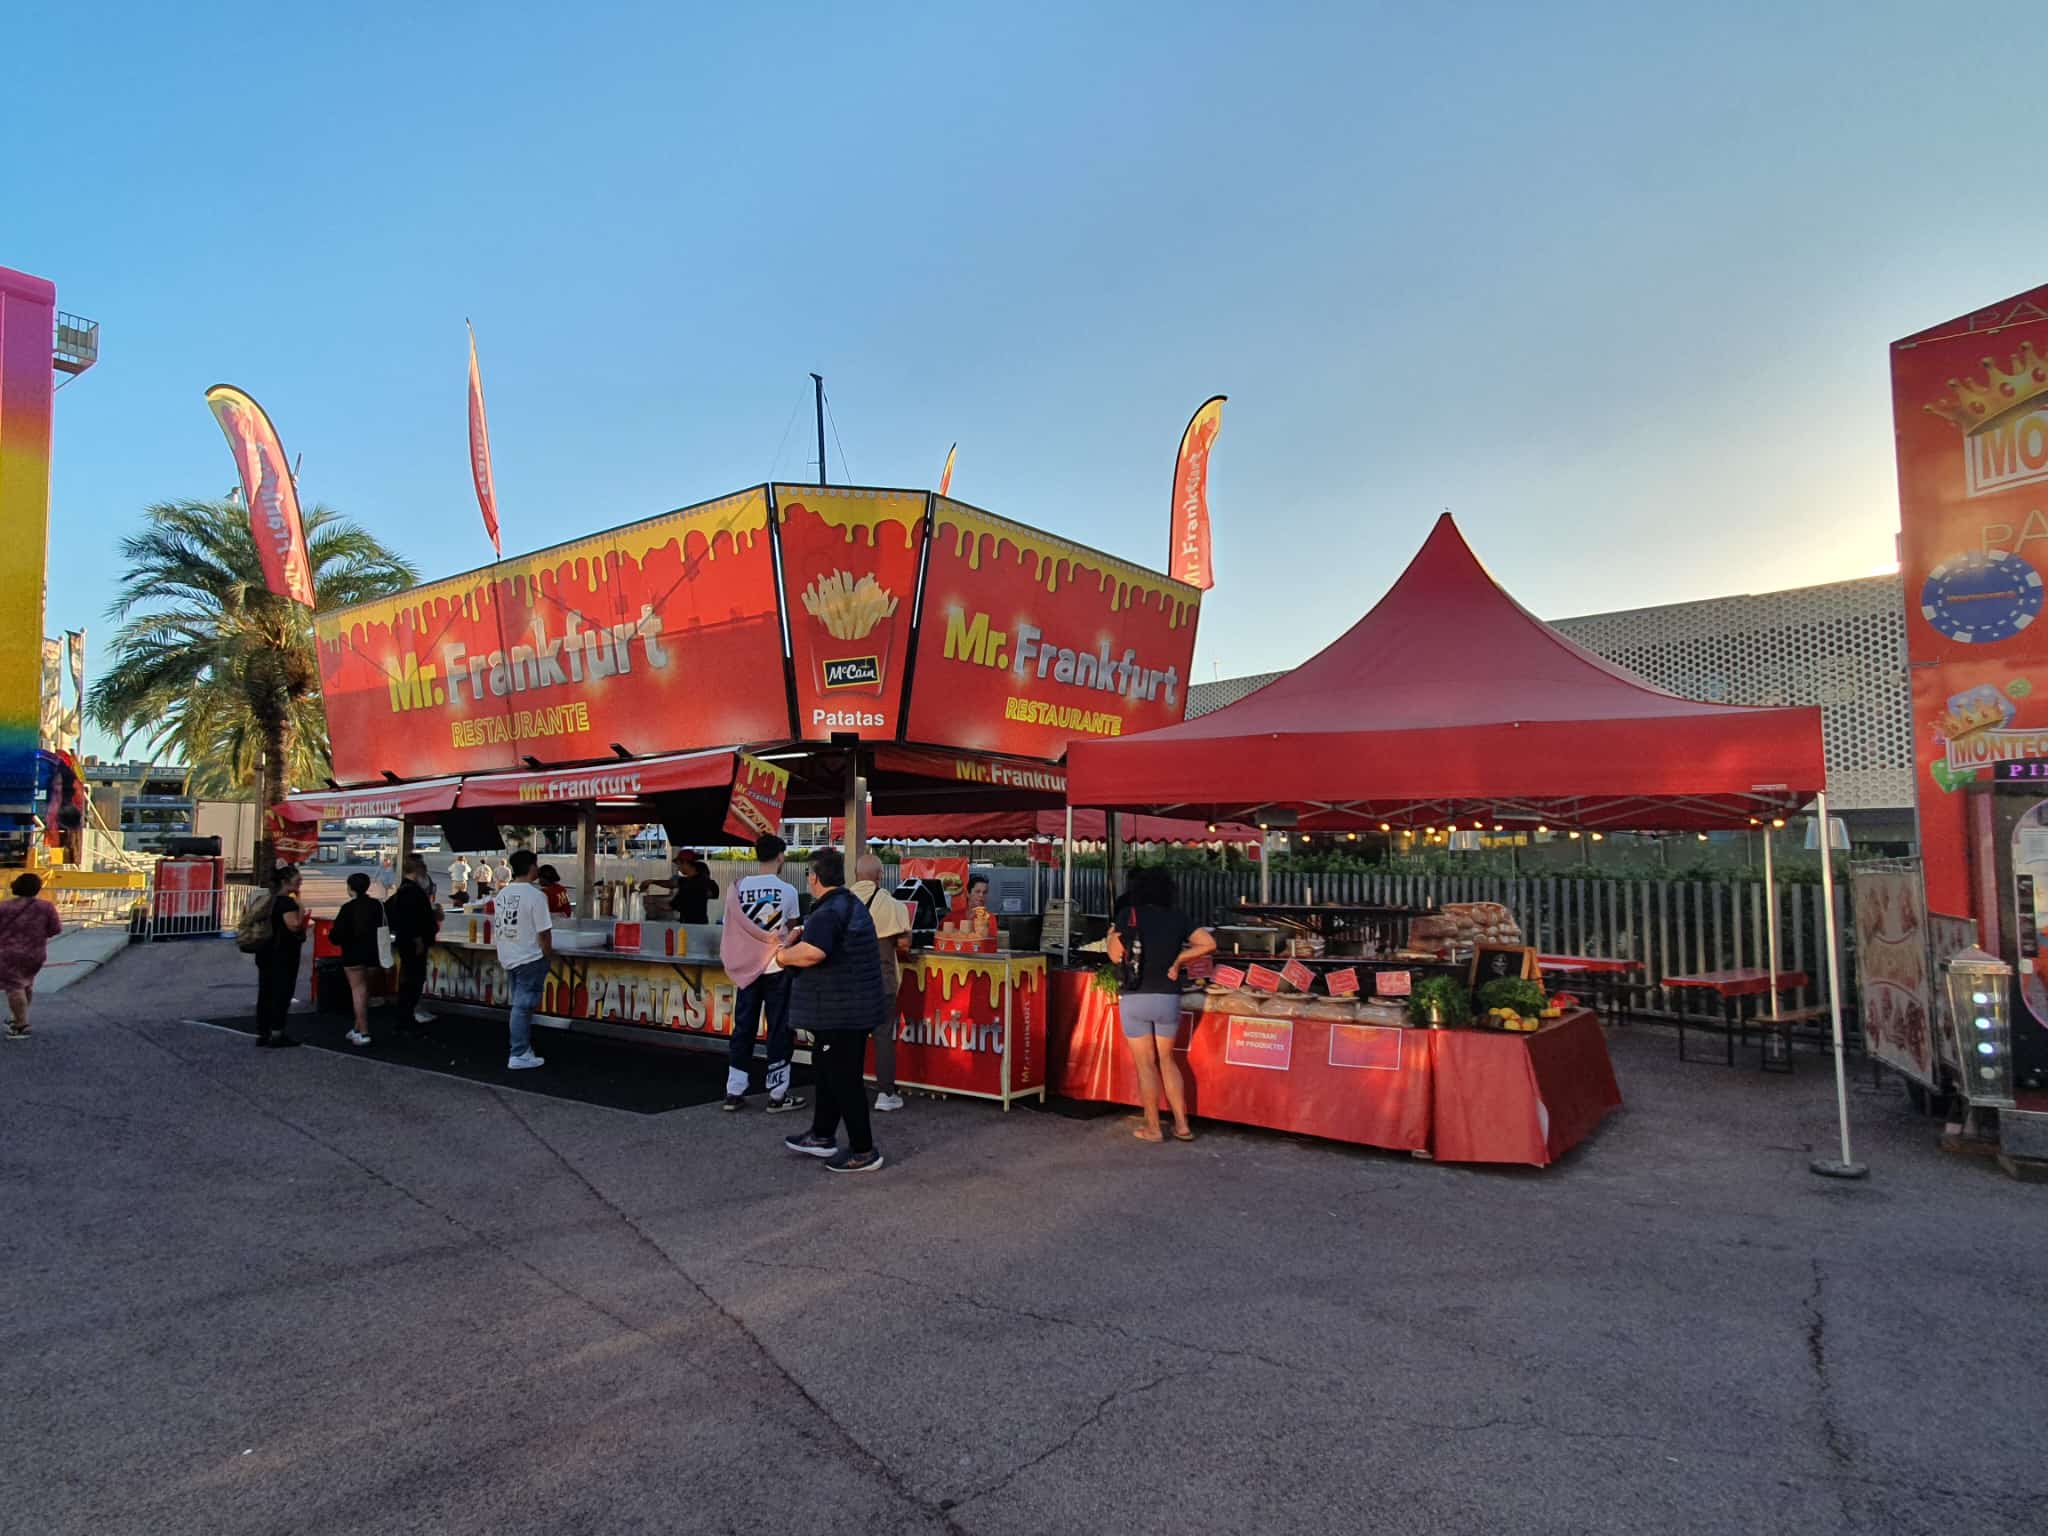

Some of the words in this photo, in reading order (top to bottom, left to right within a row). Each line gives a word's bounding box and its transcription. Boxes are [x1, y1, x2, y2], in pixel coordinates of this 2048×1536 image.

[827, 662, 878, 682] McCain
[451, 701, 590, 748] RESTAURANTE
[813, 708, 885, 728] Patatas
[1005, 697, 1123, 736] RESTAURANTE
[587, 972, 707, 1029] PATATAS
